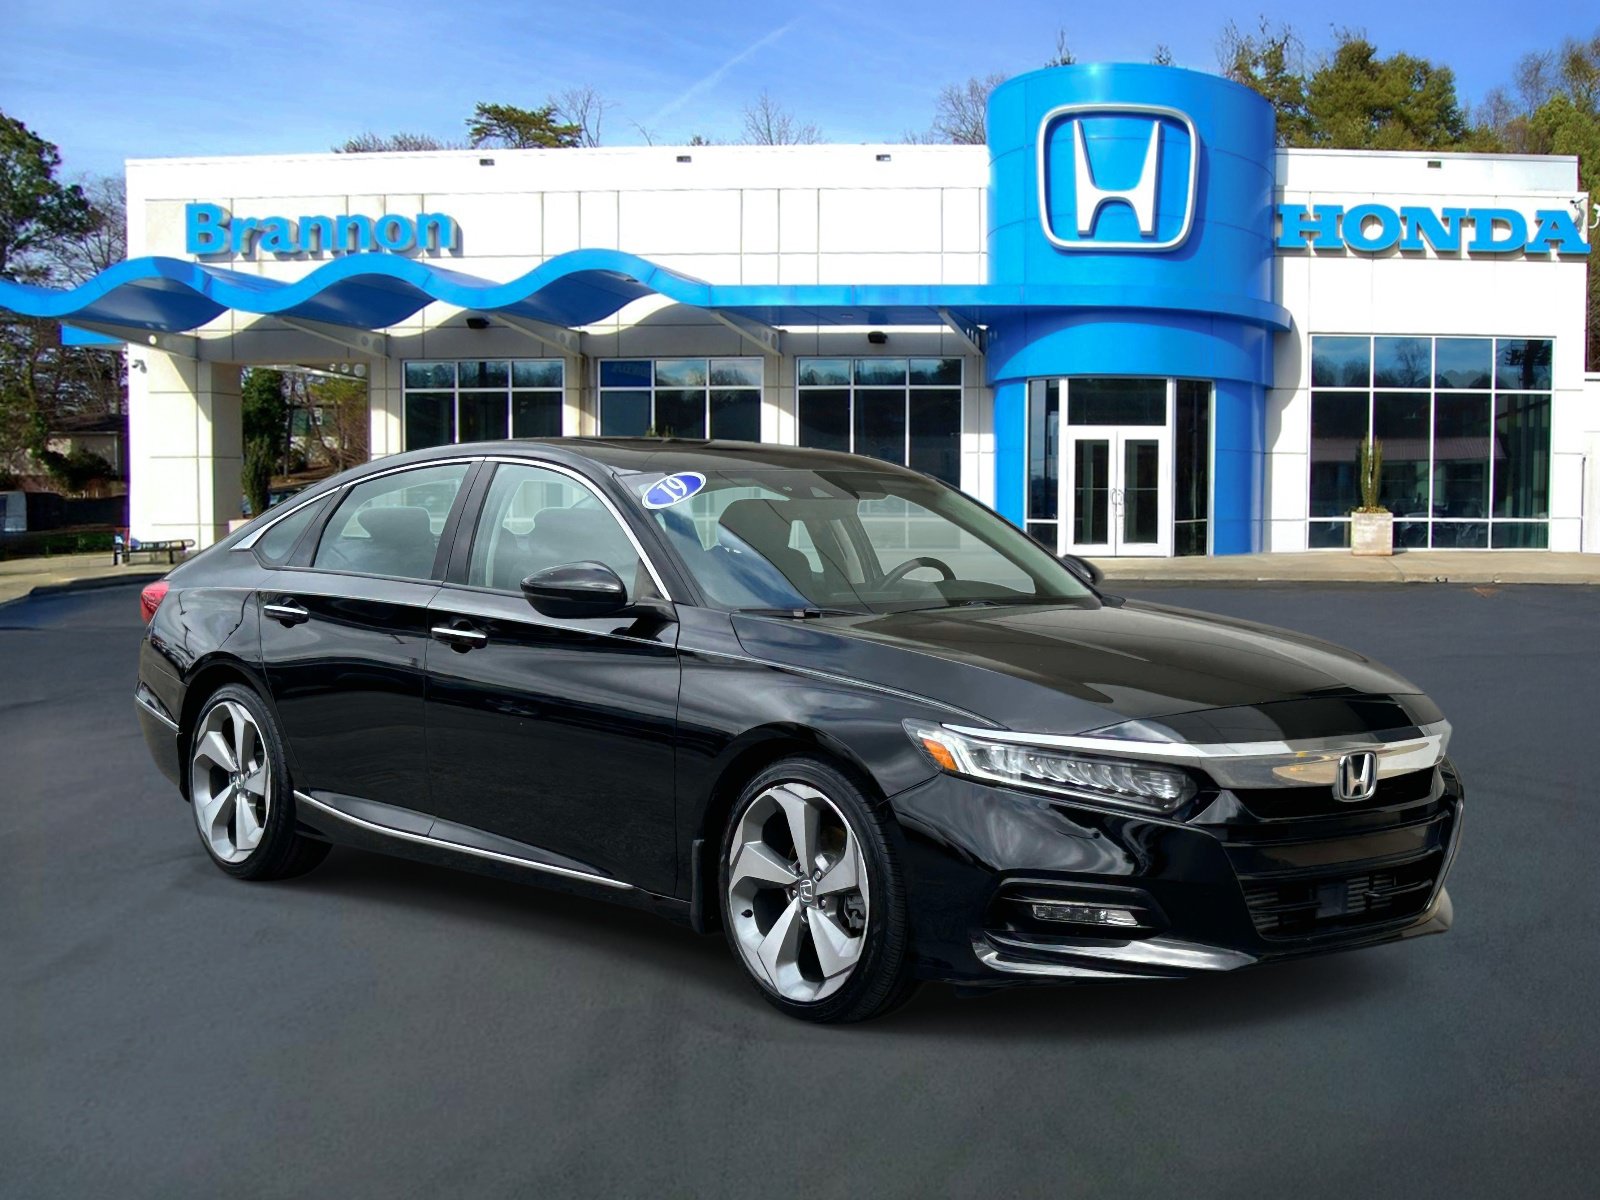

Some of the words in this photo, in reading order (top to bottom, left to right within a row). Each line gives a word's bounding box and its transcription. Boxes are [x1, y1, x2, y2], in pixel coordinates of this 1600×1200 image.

[185, 202, 456, 254] Brannon
[1277, 203, 1592, 255] HONDA
[656, 476, 688, 503] 19
